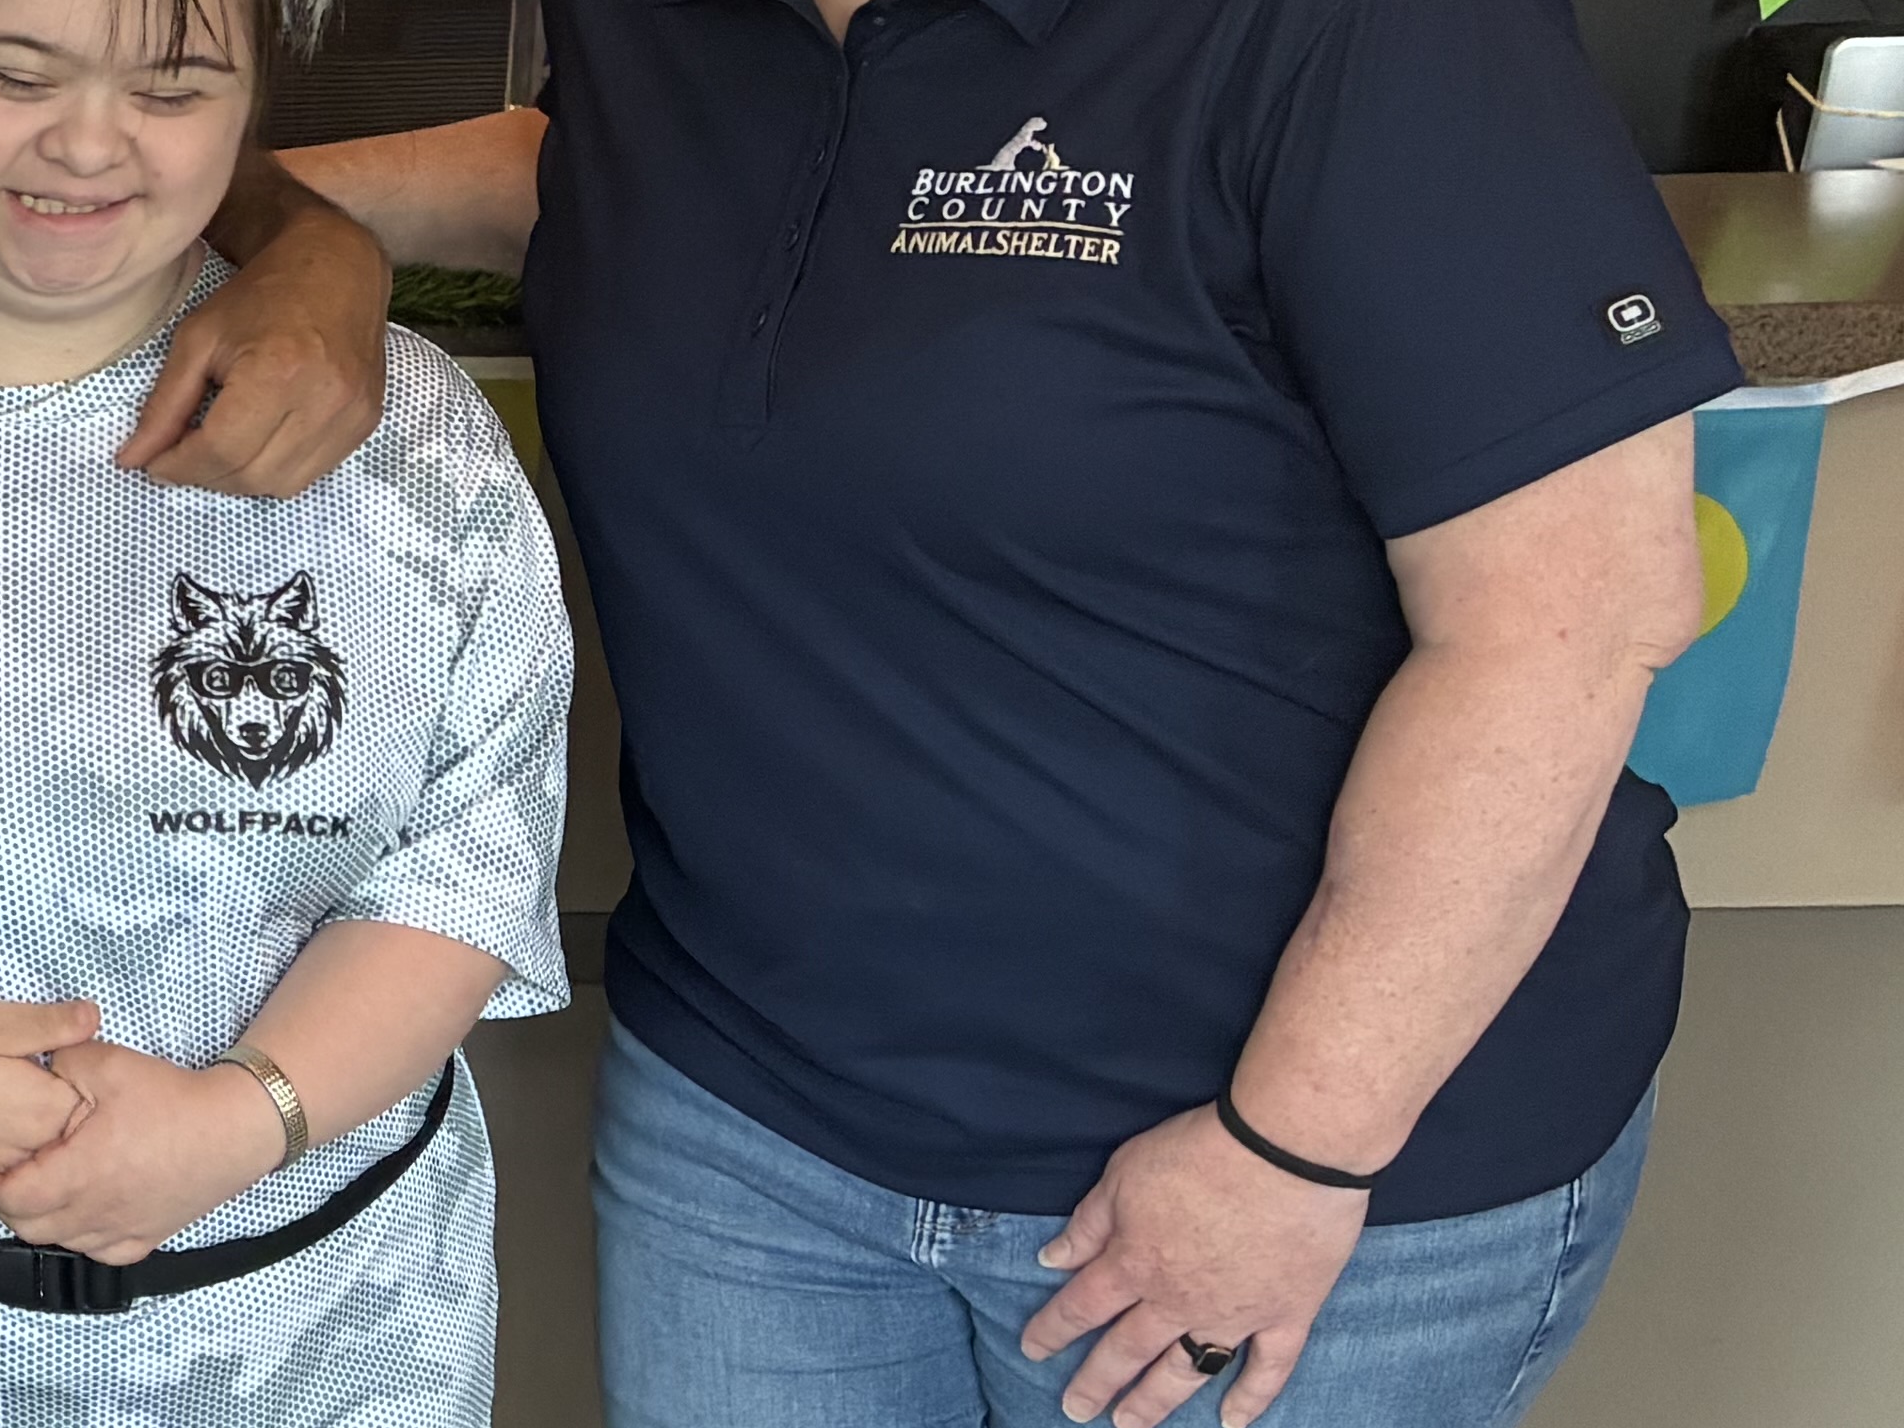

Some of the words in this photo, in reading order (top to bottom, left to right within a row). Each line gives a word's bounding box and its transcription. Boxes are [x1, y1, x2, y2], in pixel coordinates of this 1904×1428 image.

[911, 168, 1135, 199] BURLINGTON
[907, 196, 1132, 227] COUNTY
[148, 809, 354, 838] WOLFPACK
